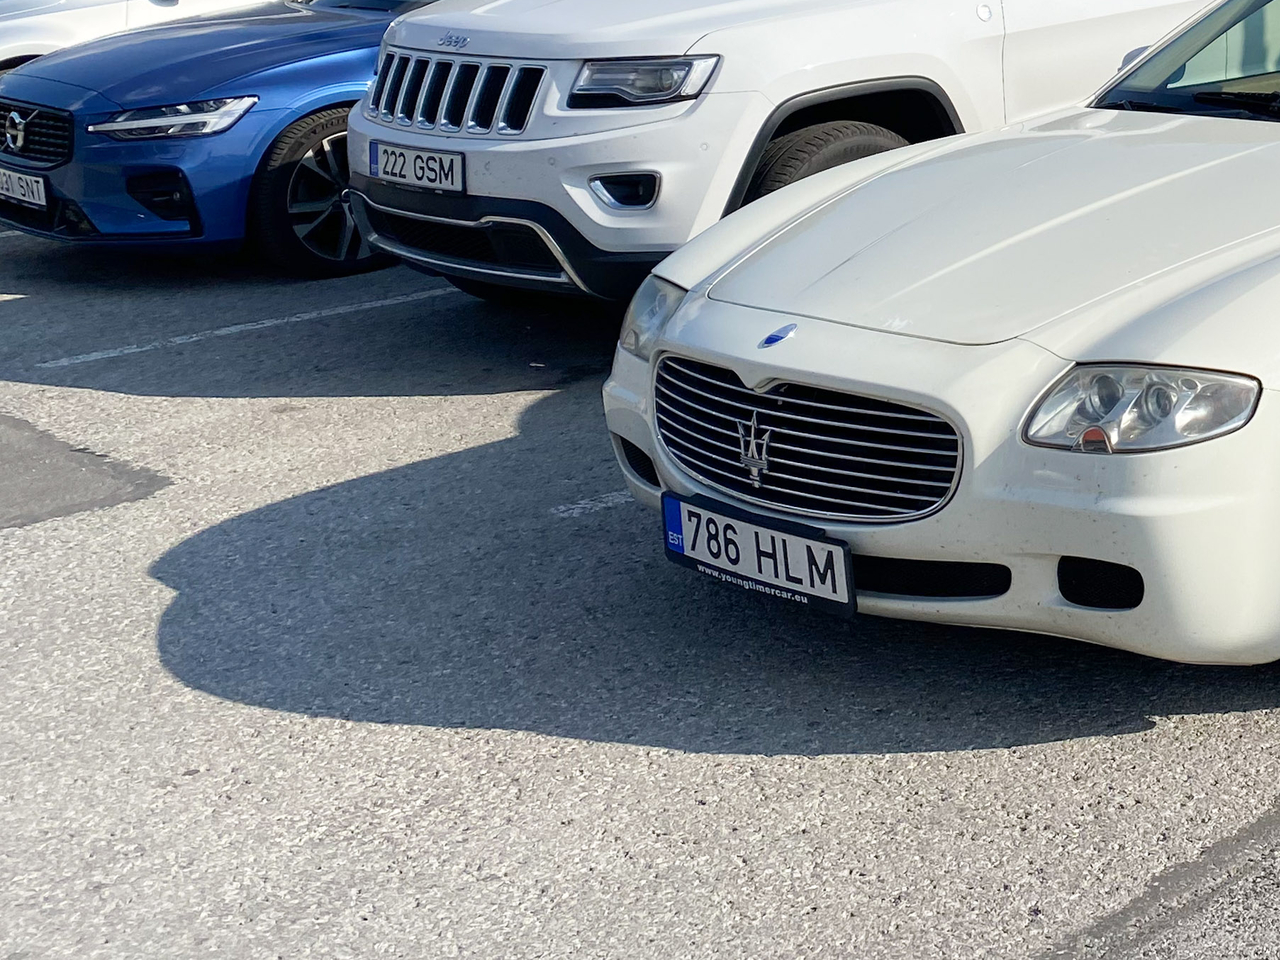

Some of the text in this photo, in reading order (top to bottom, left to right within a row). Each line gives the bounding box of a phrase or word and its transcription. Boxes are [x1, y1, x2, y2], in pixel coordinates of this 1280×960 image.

[437, 31, 471, 50] Jeep
[382, 148, 407, 180] 222
[413, 154, 454, 186] GSM
[17, 176, 41, 201] SNT
[668, 509, 838, 595] EST 786 HLM
[697, 563, 809, 604] www.youngtimercar.eu
